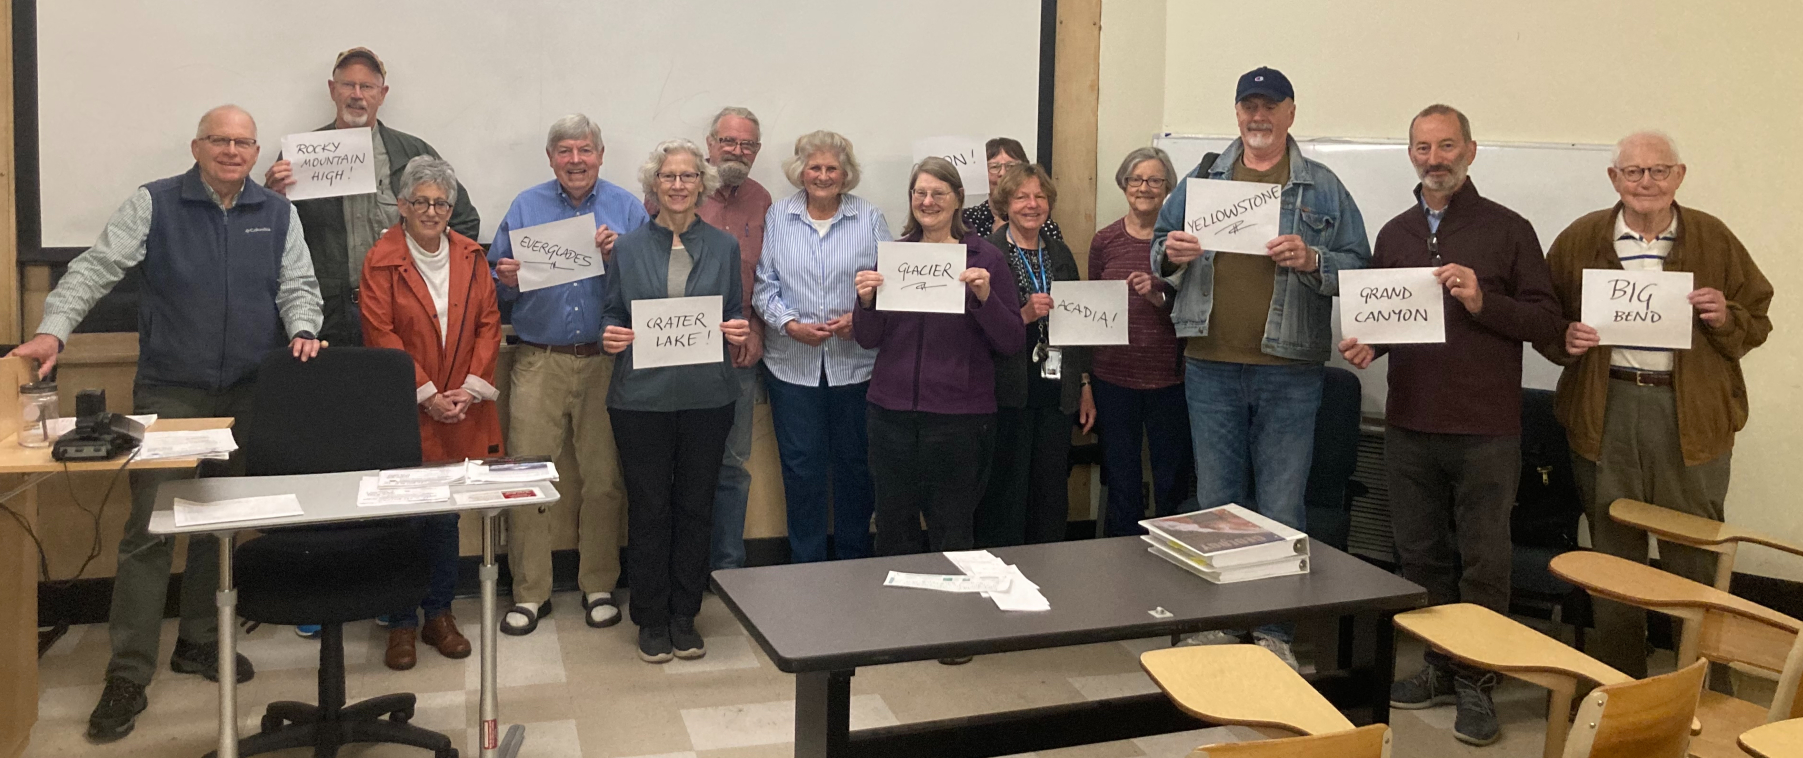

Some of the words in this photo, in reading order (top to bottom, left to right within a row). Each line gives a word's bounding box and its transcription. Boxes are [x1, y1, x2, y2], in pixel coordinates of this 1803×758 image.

[296, 142, 341, 155] ROCKY
[300, 152, 366, 168] MOUNTAIN
[1187, 185, 1281, 233] YELLOWSTONE
[519, 235, 592, 268] EVERGLADES
[897, 262, 955, 282] GLACIER
[1360, 286, 1413, 305] GRAND
[1607, 278, 1658, 311] BIG
[646, 312, 707, 331] CRATER
[1057, 299, 1118, 329] ACADIA!
[1354, 308, 1428, 323] CANYON
[1613, 310, 1662, 323] BEND
